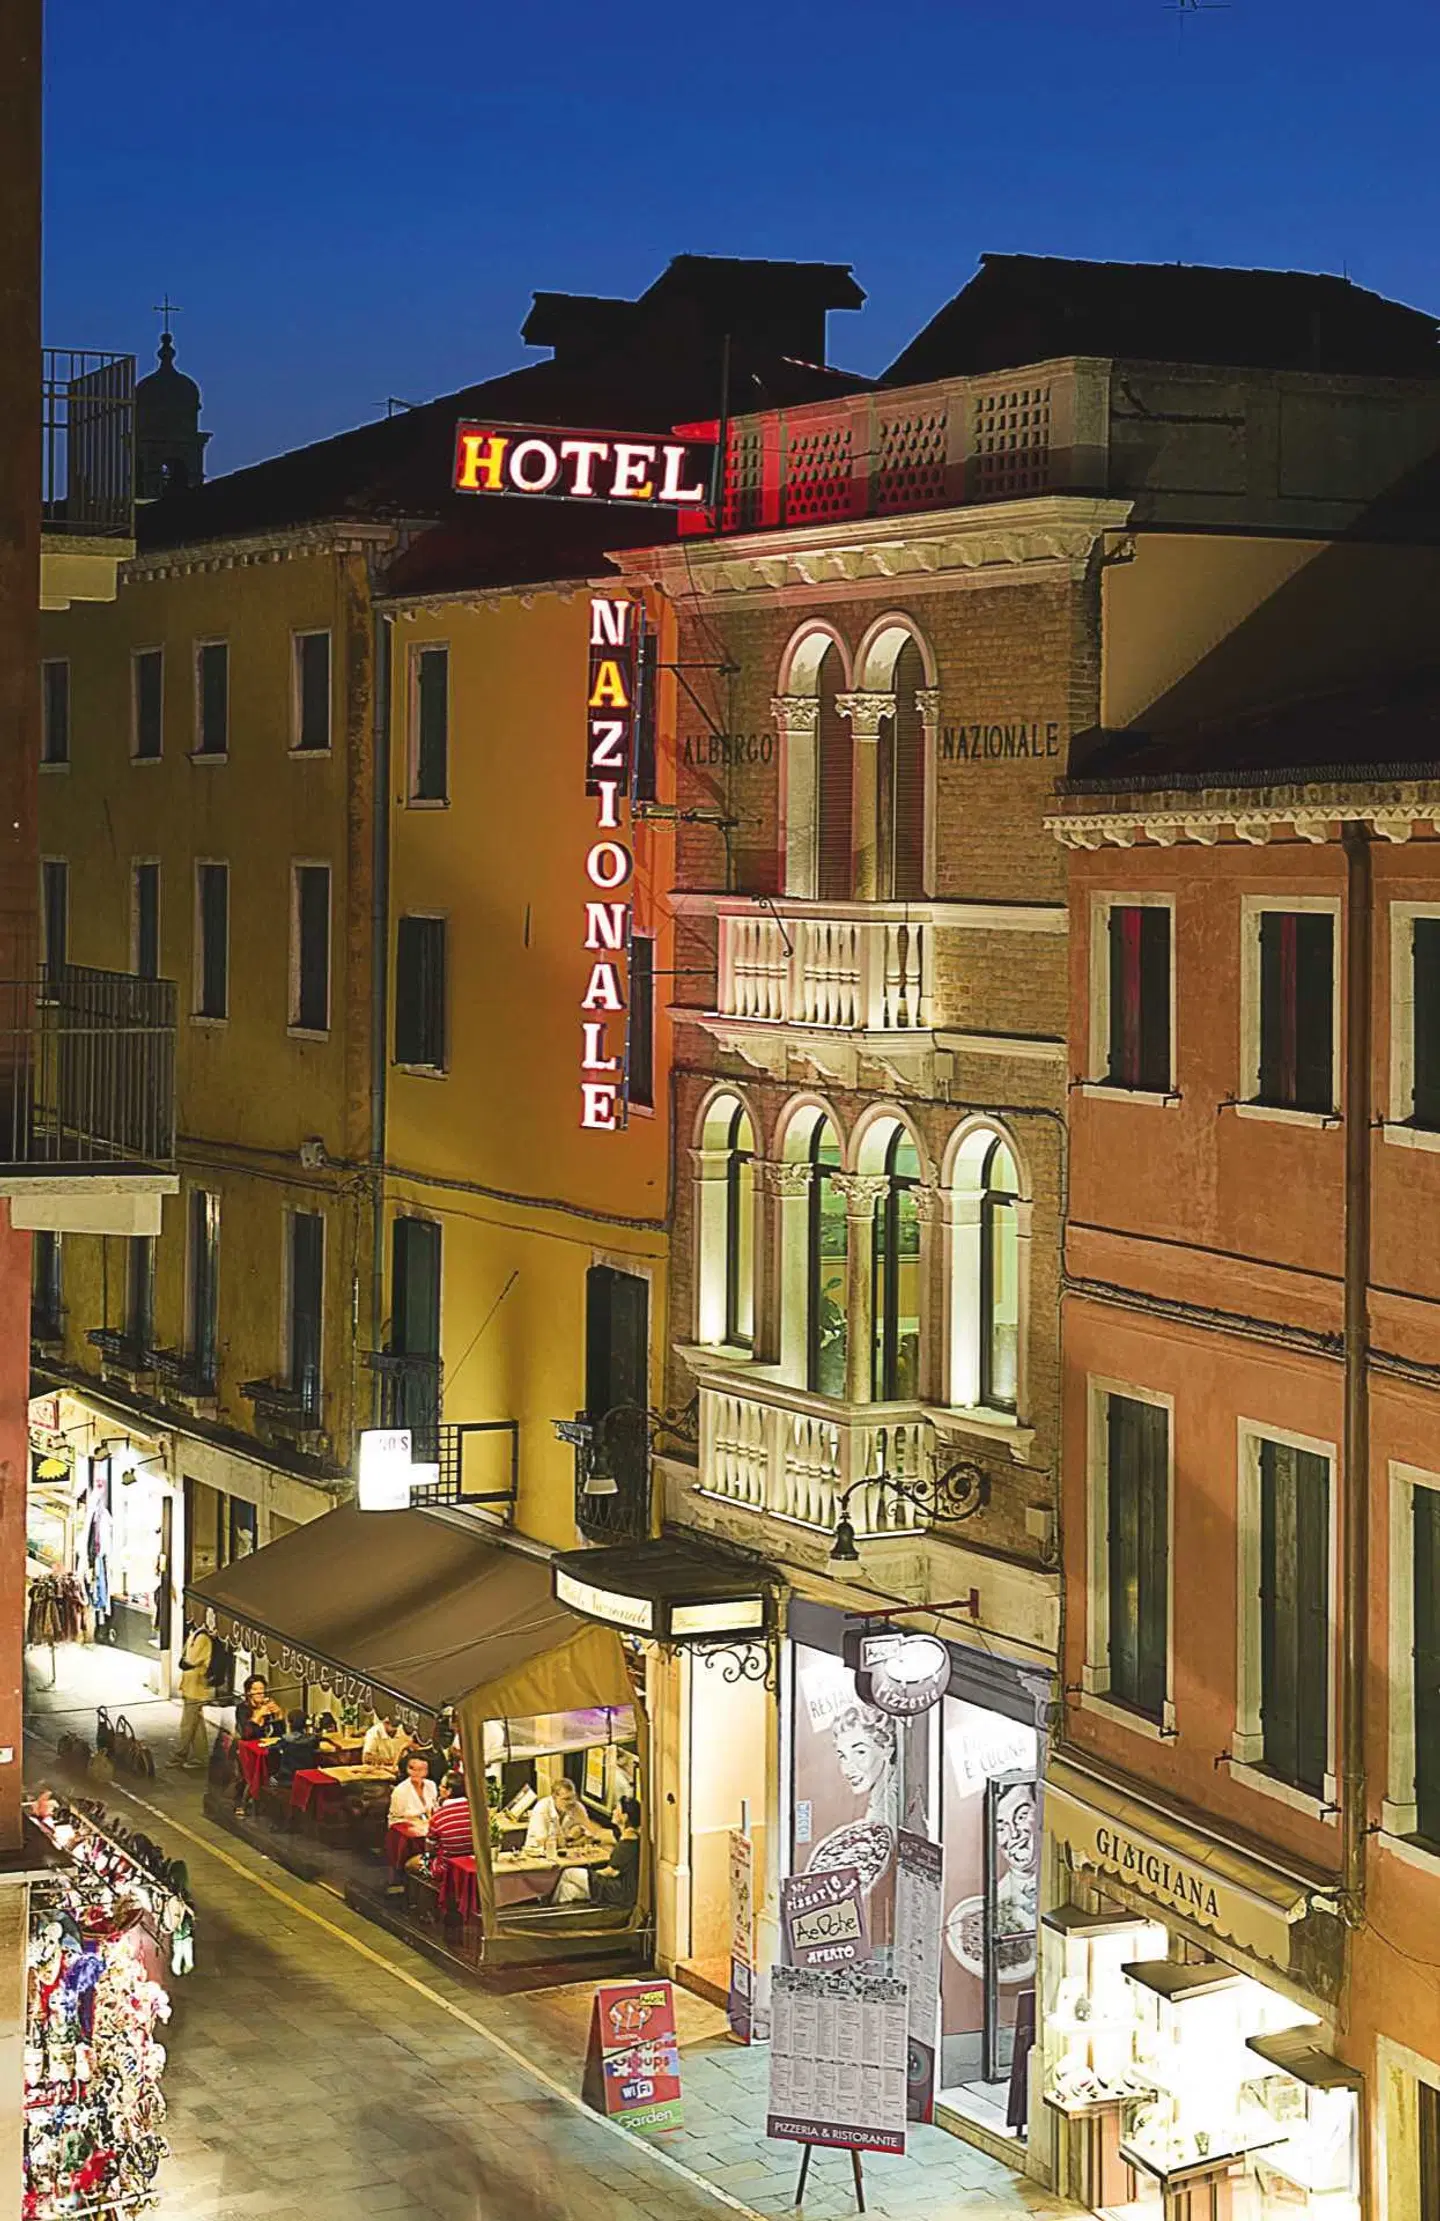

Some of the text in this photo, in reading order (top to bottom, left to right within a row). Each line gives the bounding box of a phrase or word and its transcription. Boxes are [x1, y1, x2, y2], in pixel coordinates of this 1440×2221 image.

[459, 435, 704, 502] HOTEL
[684, 722, 1060, 765] ALBERGO NAZIONALE
[581, 598, 631, 1131] NAZIONALE
[807, 1945, 855, 1963] APERTO
[618, 2108, 673, 2129] Garden
[774, 2121, 899, 2148] PIZZERIA & RISTORANTE
